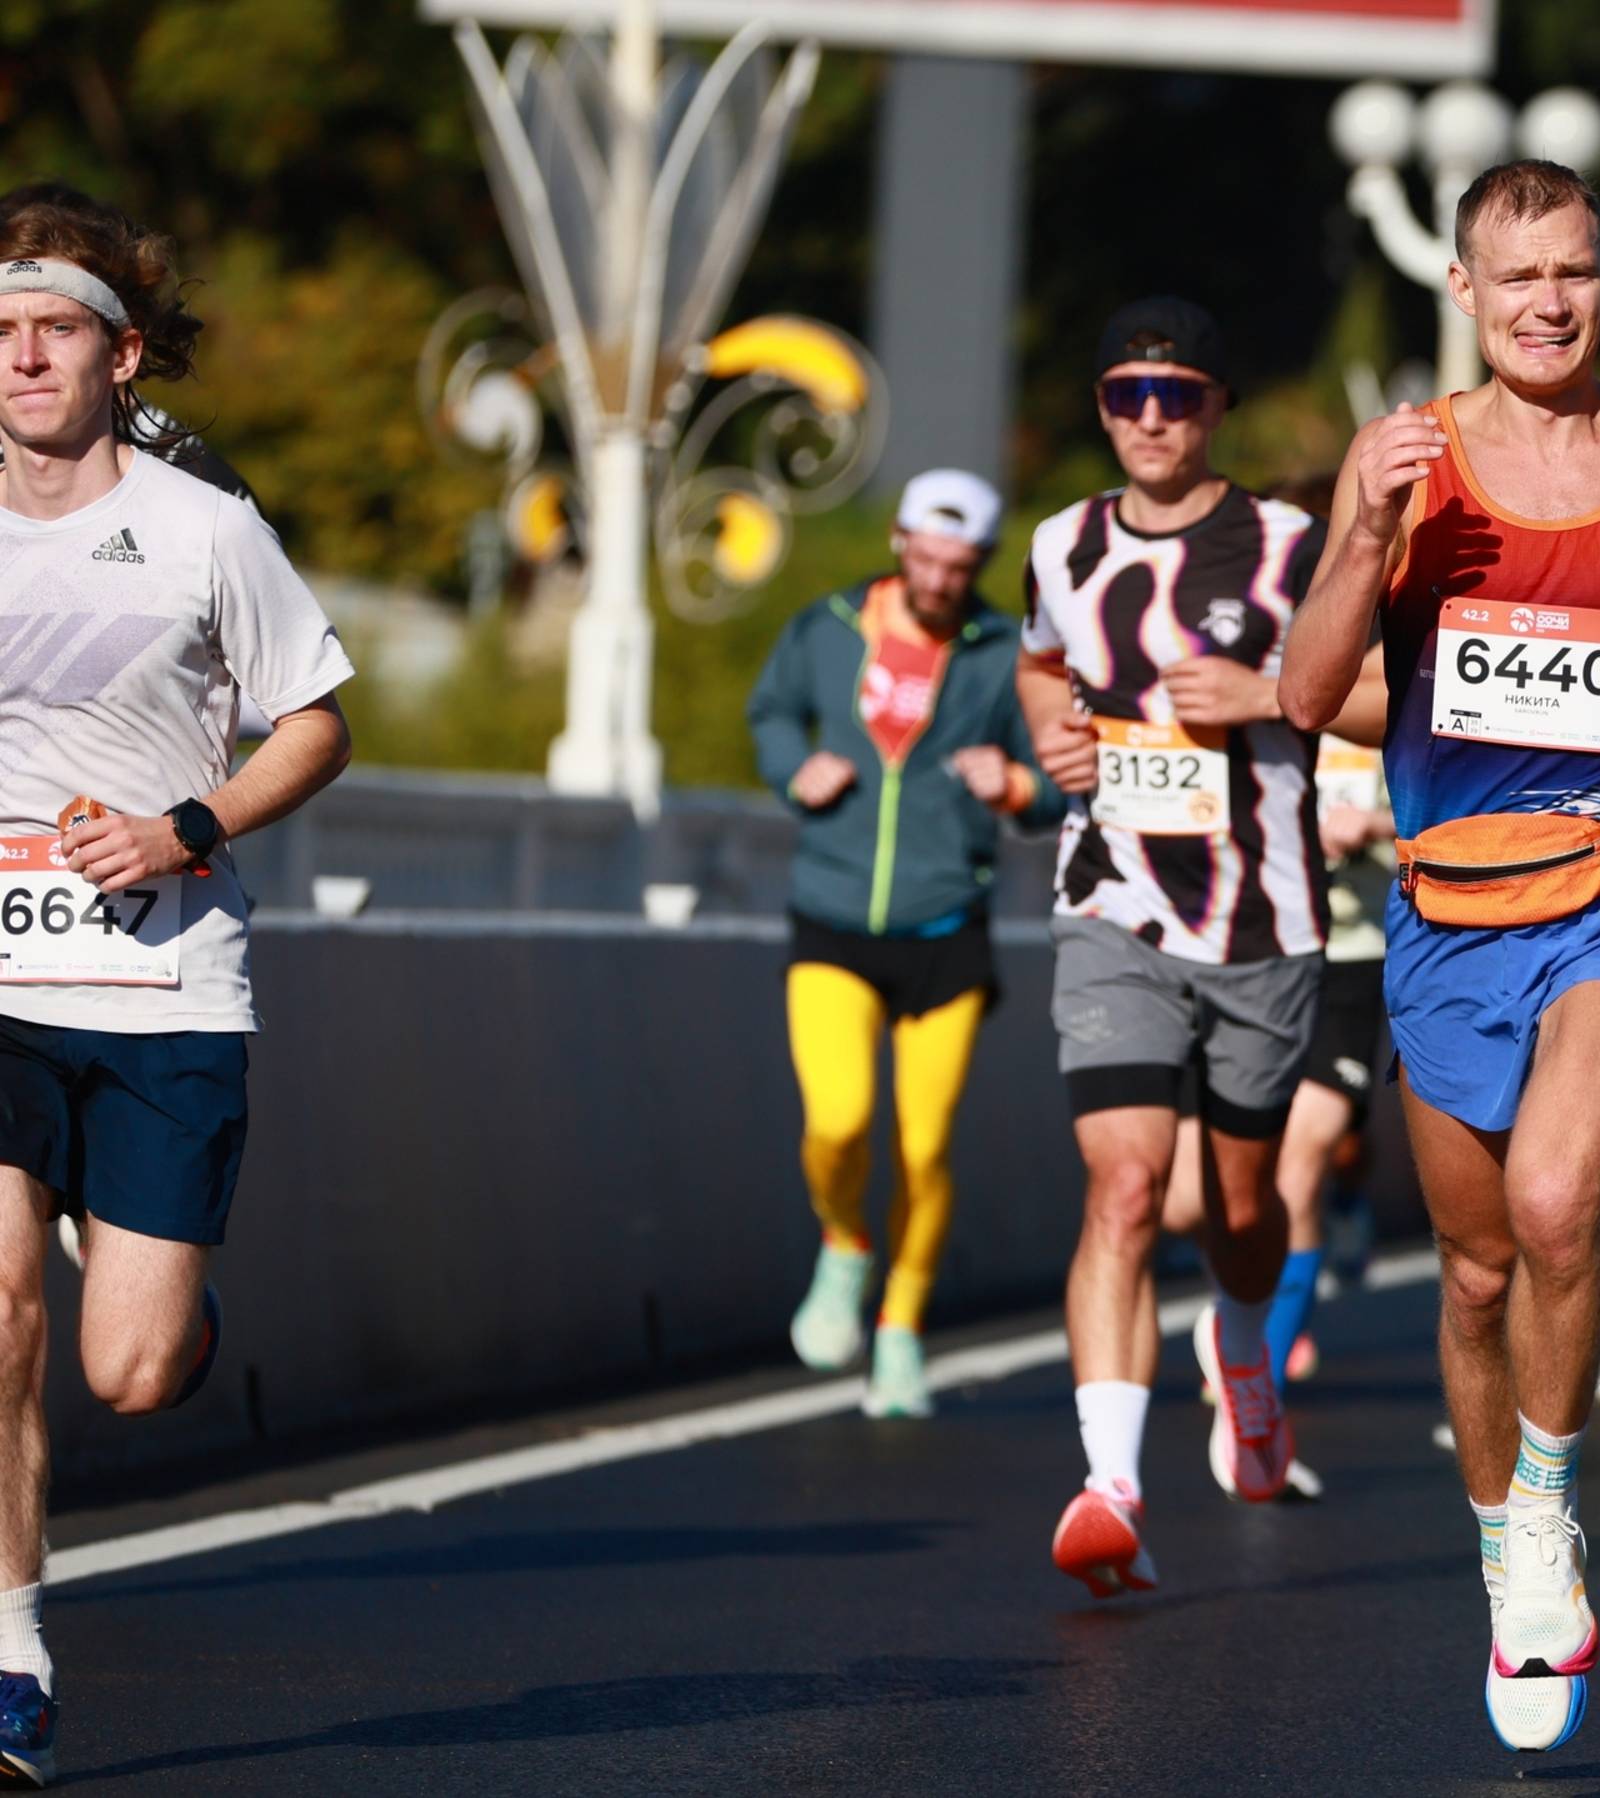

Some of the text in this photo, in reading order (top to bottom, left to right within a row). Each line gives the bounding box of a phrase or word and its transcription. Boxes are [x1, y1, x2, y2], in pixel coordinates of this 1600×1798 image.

[91, 549, 145, 564] adidas
[1461, 608, 1489, 622] 42.2
[1504, 693, 1561, 708] НИКИТА
[1104, 751, 1202, 789] 3132
[2, 887, 159, 935] 6647
